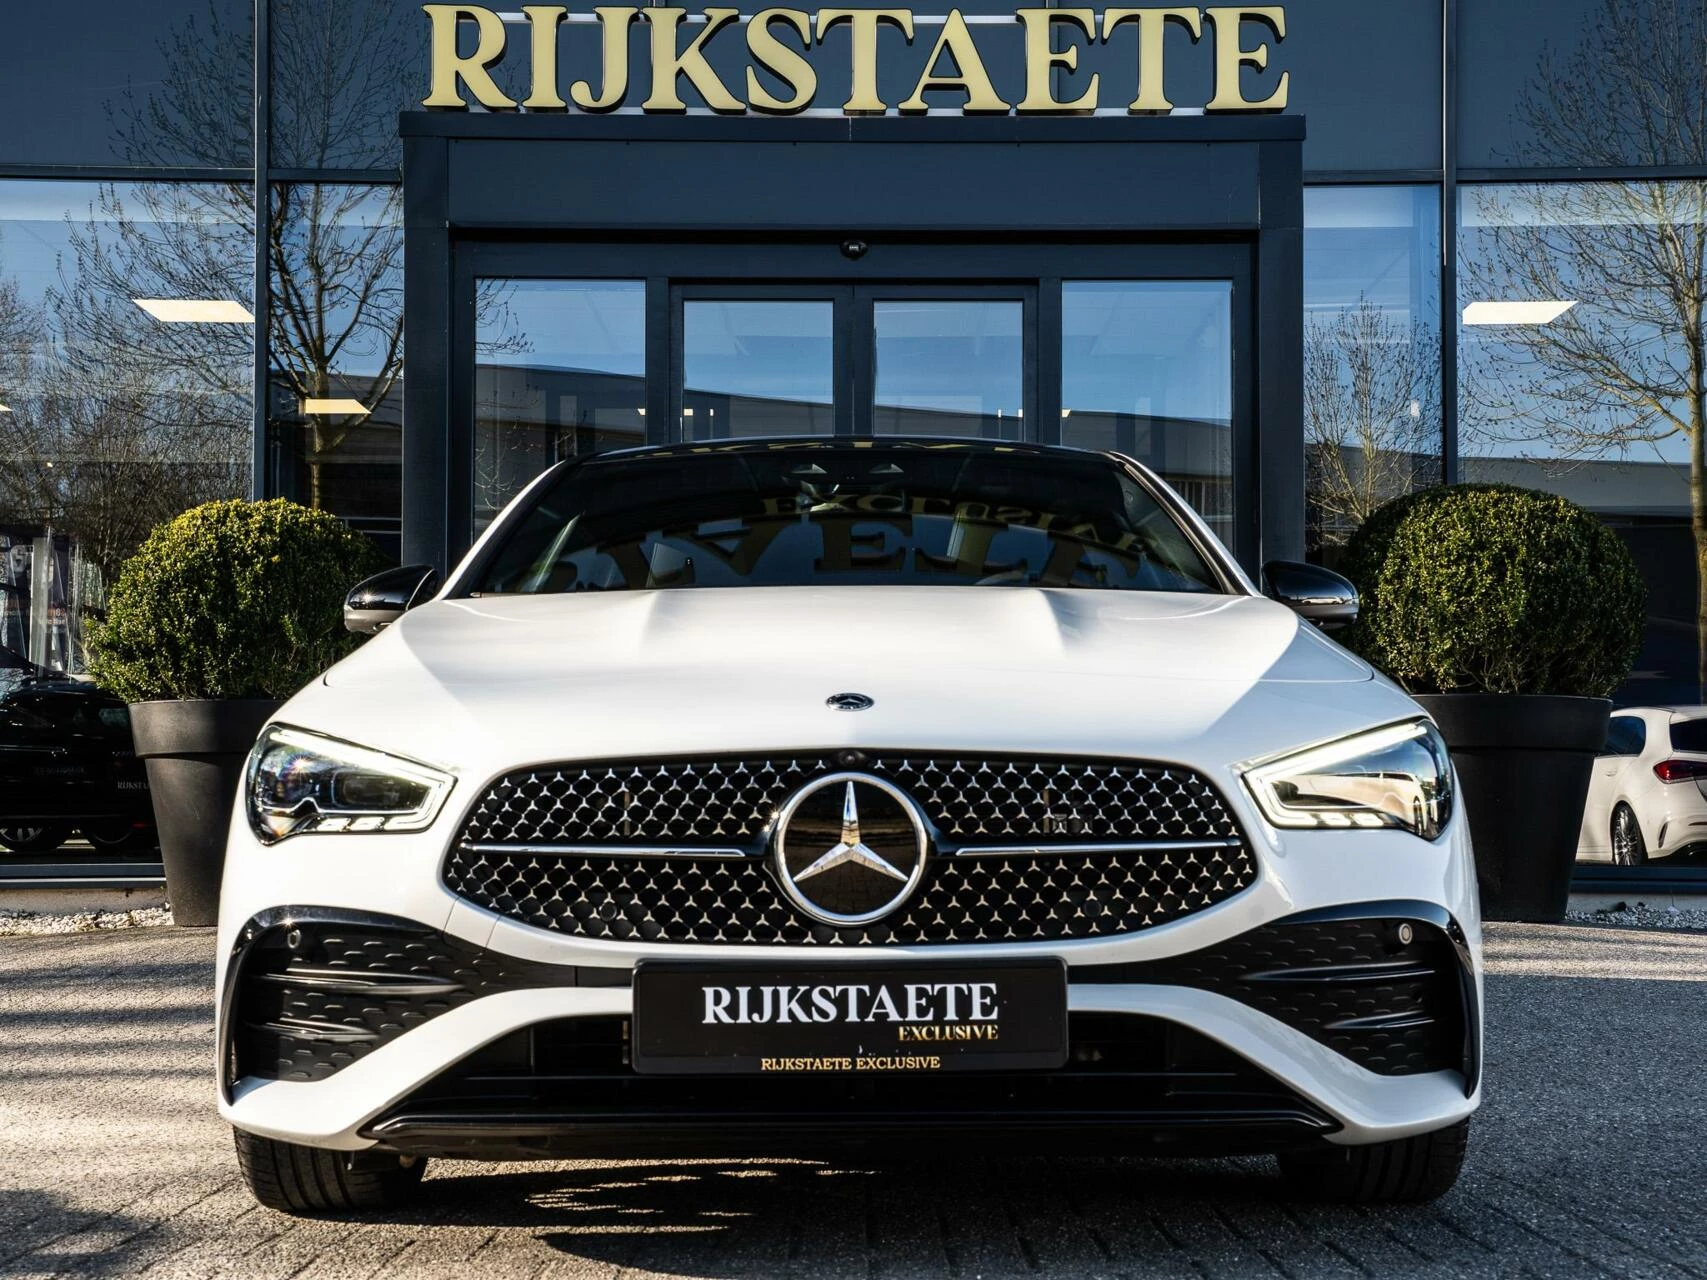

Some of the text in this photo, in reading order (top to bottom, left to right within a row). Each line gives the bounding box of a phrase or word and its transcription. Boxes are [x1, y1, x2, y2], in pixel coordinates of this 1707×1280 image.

[422, 4, 1290, 116] RIJKSTAETE
[701, 982, 999, 1025] RIJKSTAETE
[898, 1024, 999, 1041] EXCLUSIVE
[760, 1055, 941, 1072] RIJKSTAETE EXCLUSIVE
